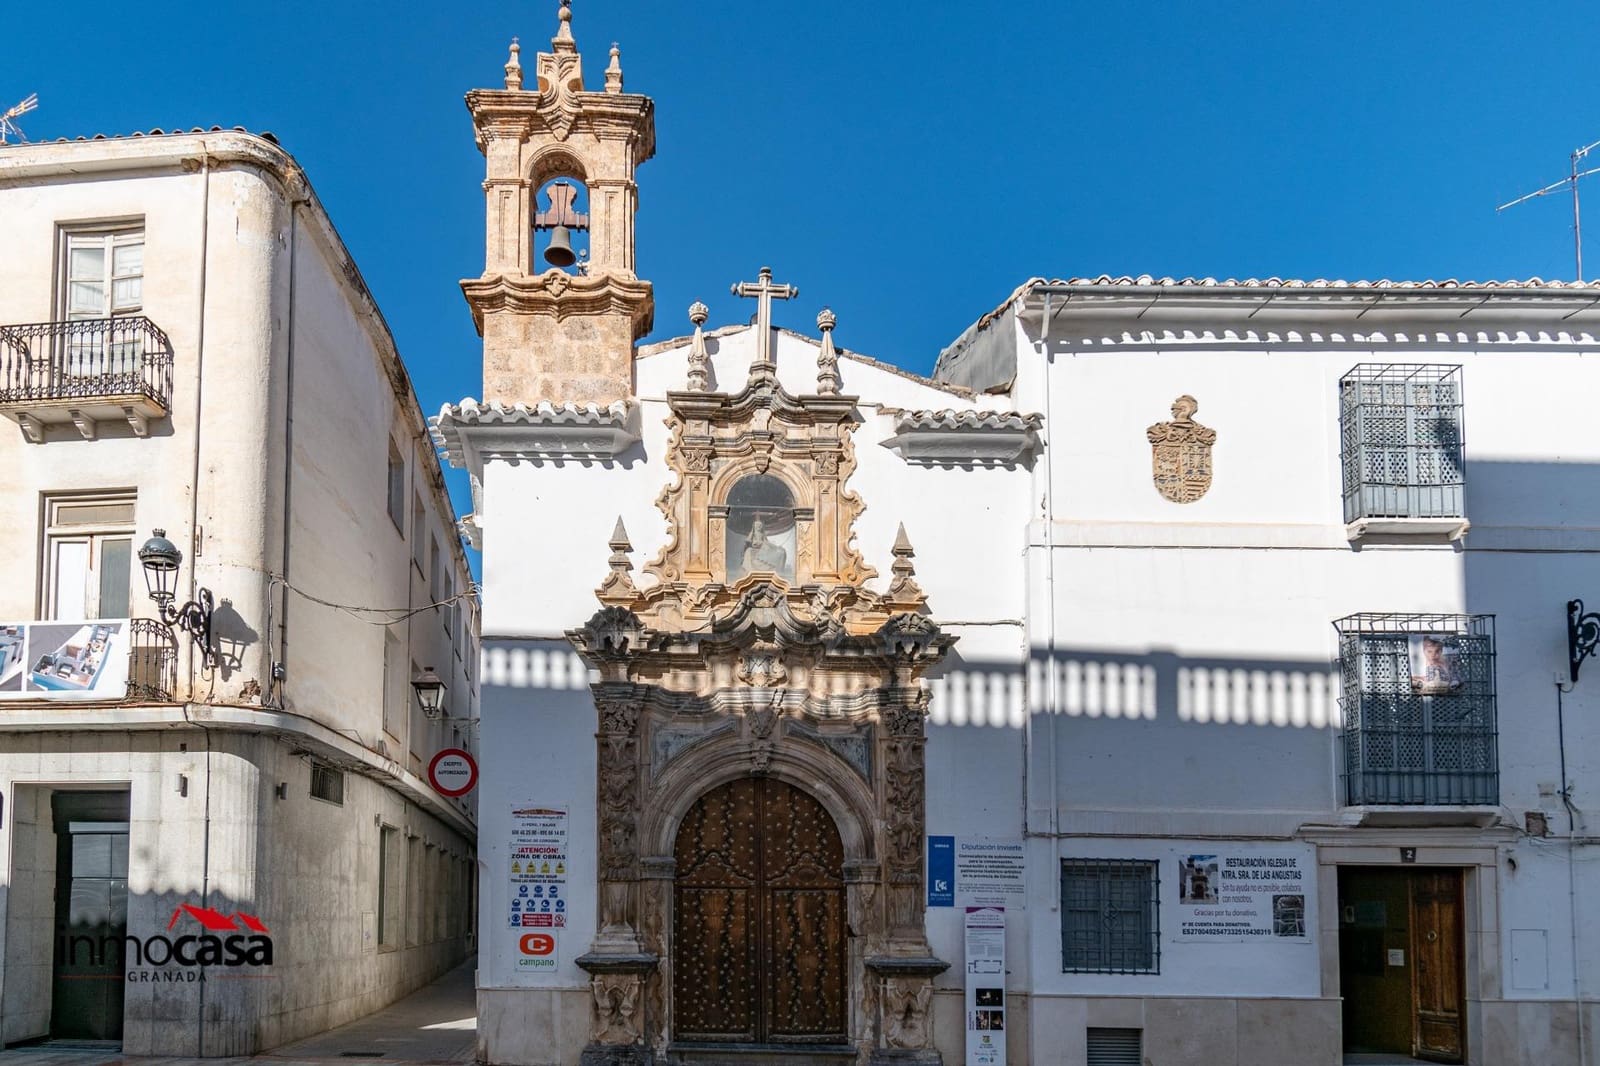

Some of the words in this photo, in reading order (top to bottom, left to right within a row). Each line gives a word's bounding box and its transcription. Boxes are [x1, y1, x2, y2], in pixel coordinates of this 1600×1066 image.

[1406, 850, 1413, 858] 2
[1226, 856, 1266, 868] RESTAURACIÓN
[1267, 858, 1288, 868] IGLESIA
[1289, 858, 1296, 868] DE
[1221, 870, 1237, 880] NTRA.
[1238, 870, 1251, 880] SRA.
[1252, 870, 1260, 880] DE
[1261, 870, 1270, 880] LAS
[1272, 870, 1302, 880] ANGUSTIAS
[1236, 884, 1249, 894] ayuda
[1282, 884, 1301, 892] colabora
[520, 959, 554, 967] campano
